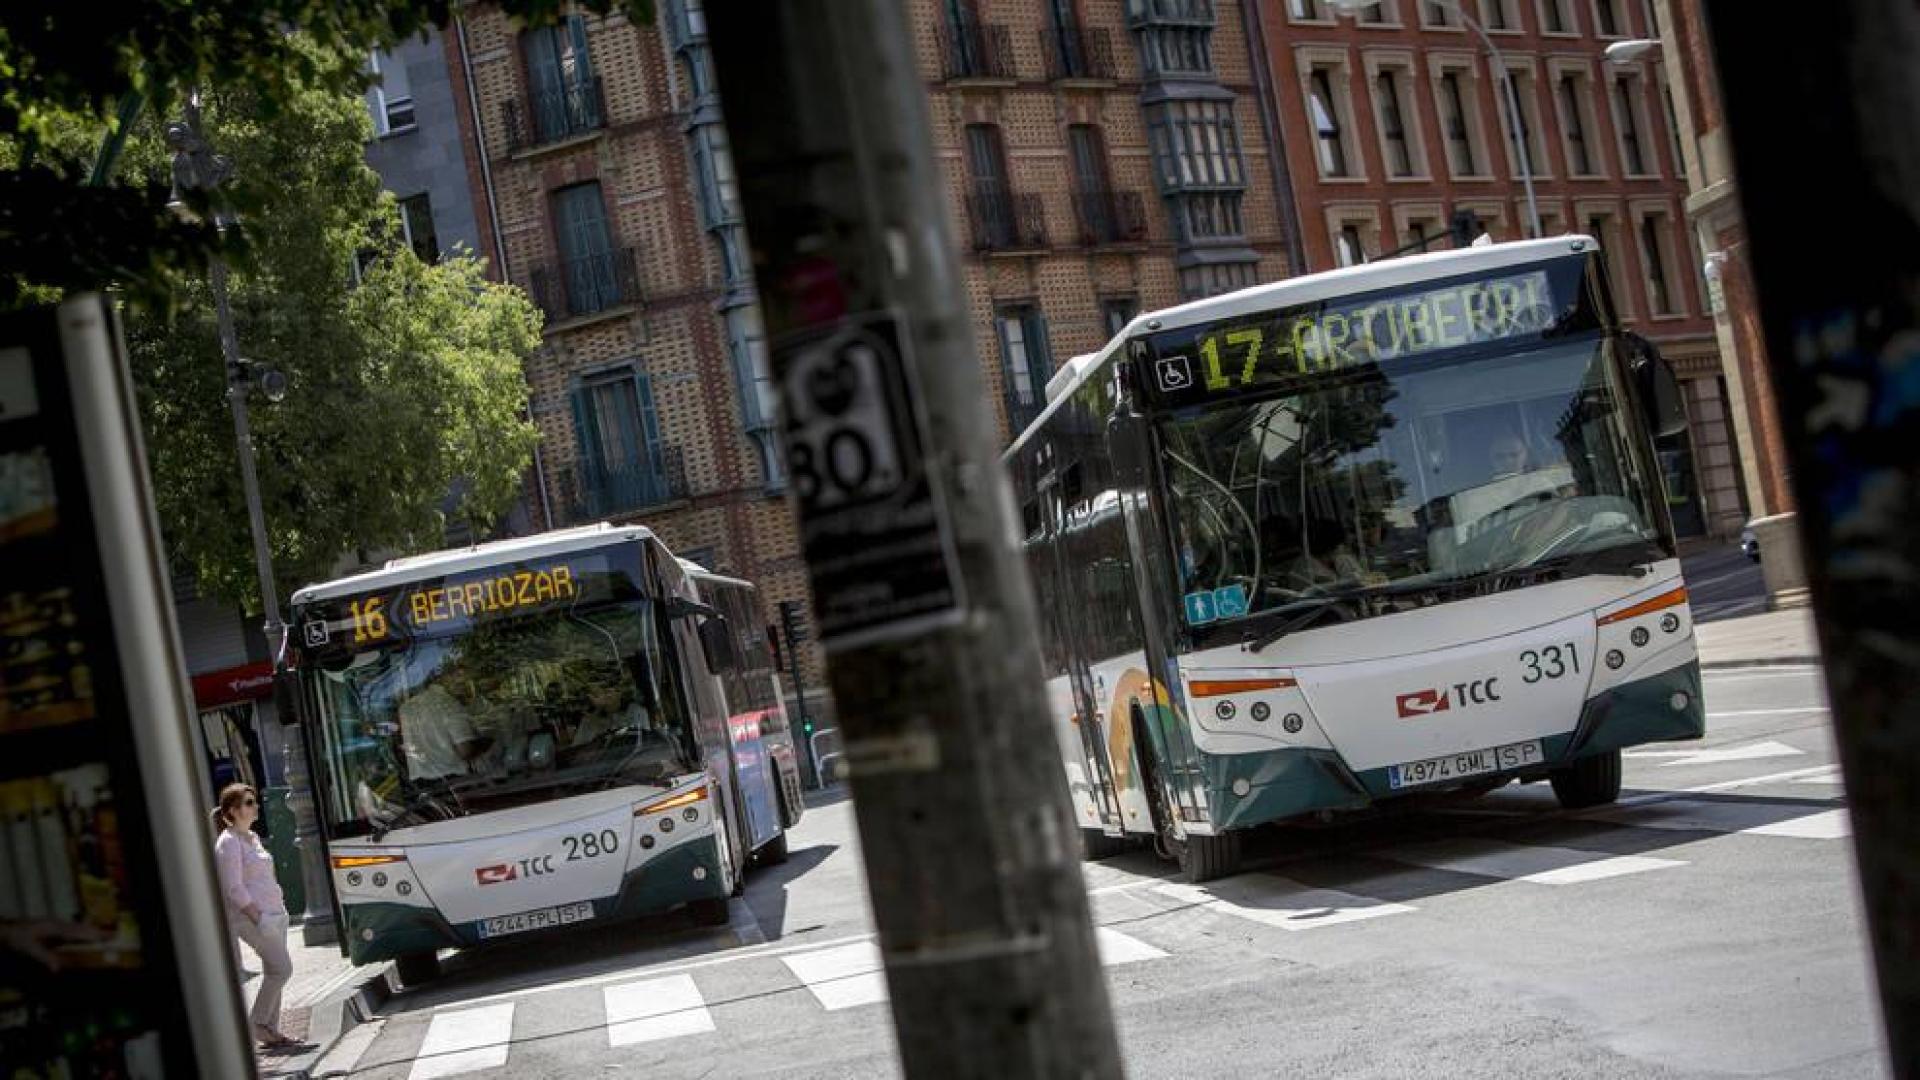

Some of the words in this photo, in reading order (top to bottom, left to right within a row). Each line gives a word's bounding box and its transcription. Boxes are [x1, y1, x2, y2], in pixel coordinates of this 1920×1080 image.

[1201, 330, 1263, 391] 17
[350, 597, 388, 642] 16
[410, 565, 574, 625] BERRIOZAR
[1520, 642, 1580, 684] 331
[1454, 677, 1500, 707] TCC
[1403, 761, 1449, 782] 4974
[1456, 754, 1491, 773] GML
[562, 829, 618, 861] 280
[518, 855, 554, 877] TCC
